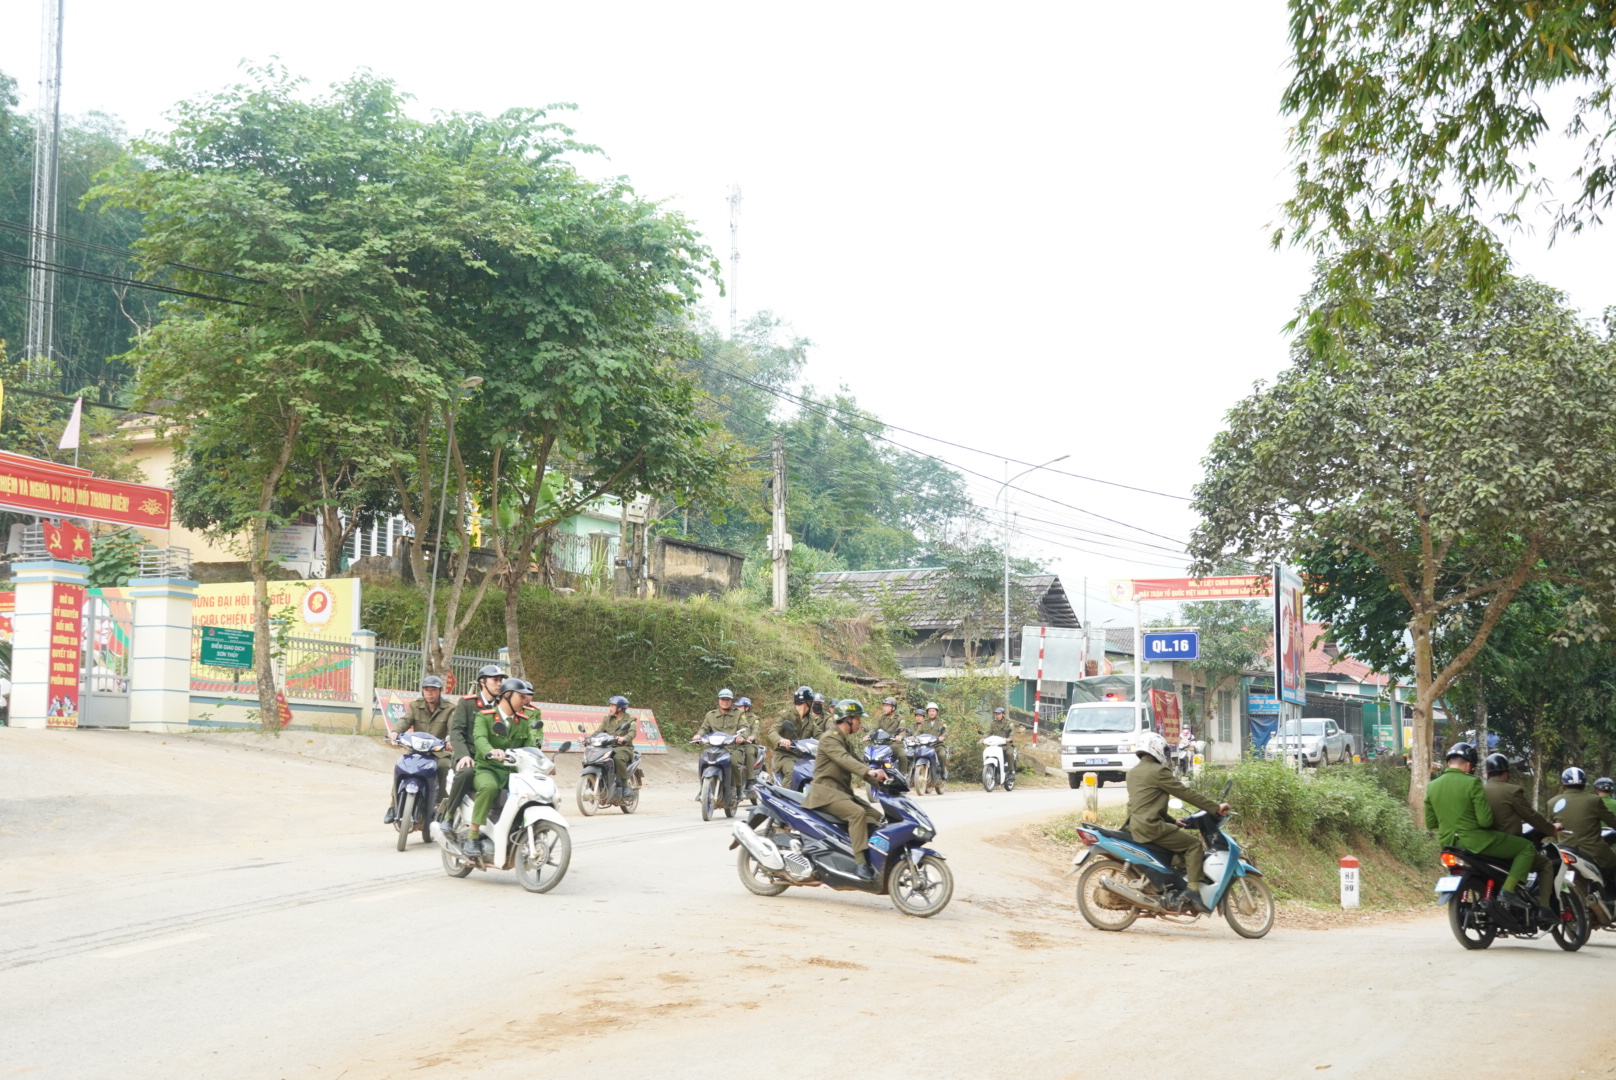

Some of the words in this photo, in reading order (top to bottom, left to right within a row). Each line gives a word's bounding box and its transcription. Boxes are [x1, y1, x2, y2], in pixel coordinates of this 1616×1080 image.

[29, 480, 50, 499] NGHĨA
[51, 484, 61, 505] VỤ
[61, 481, 75, 504] CỦA
[76, 484, 89, 506] MỖI
[90, 491, 111, 510] THANH
[112, 493, 129, 512] NIÊN!
[1151, 590, 1164, 598] TRẬN
[1172, 588, 1185, 597] QUỐC
[1186, 588, 1197, 597] VIỆT
[1210, 586, 1222, 596] TỈNH
[218, 596, 232, 609] ĐẠI
[235, 592, 250, 609] HỘI
[220, 610, 246, 625] CHIẾN
[1152, 640, 1189, 654] QL.16
